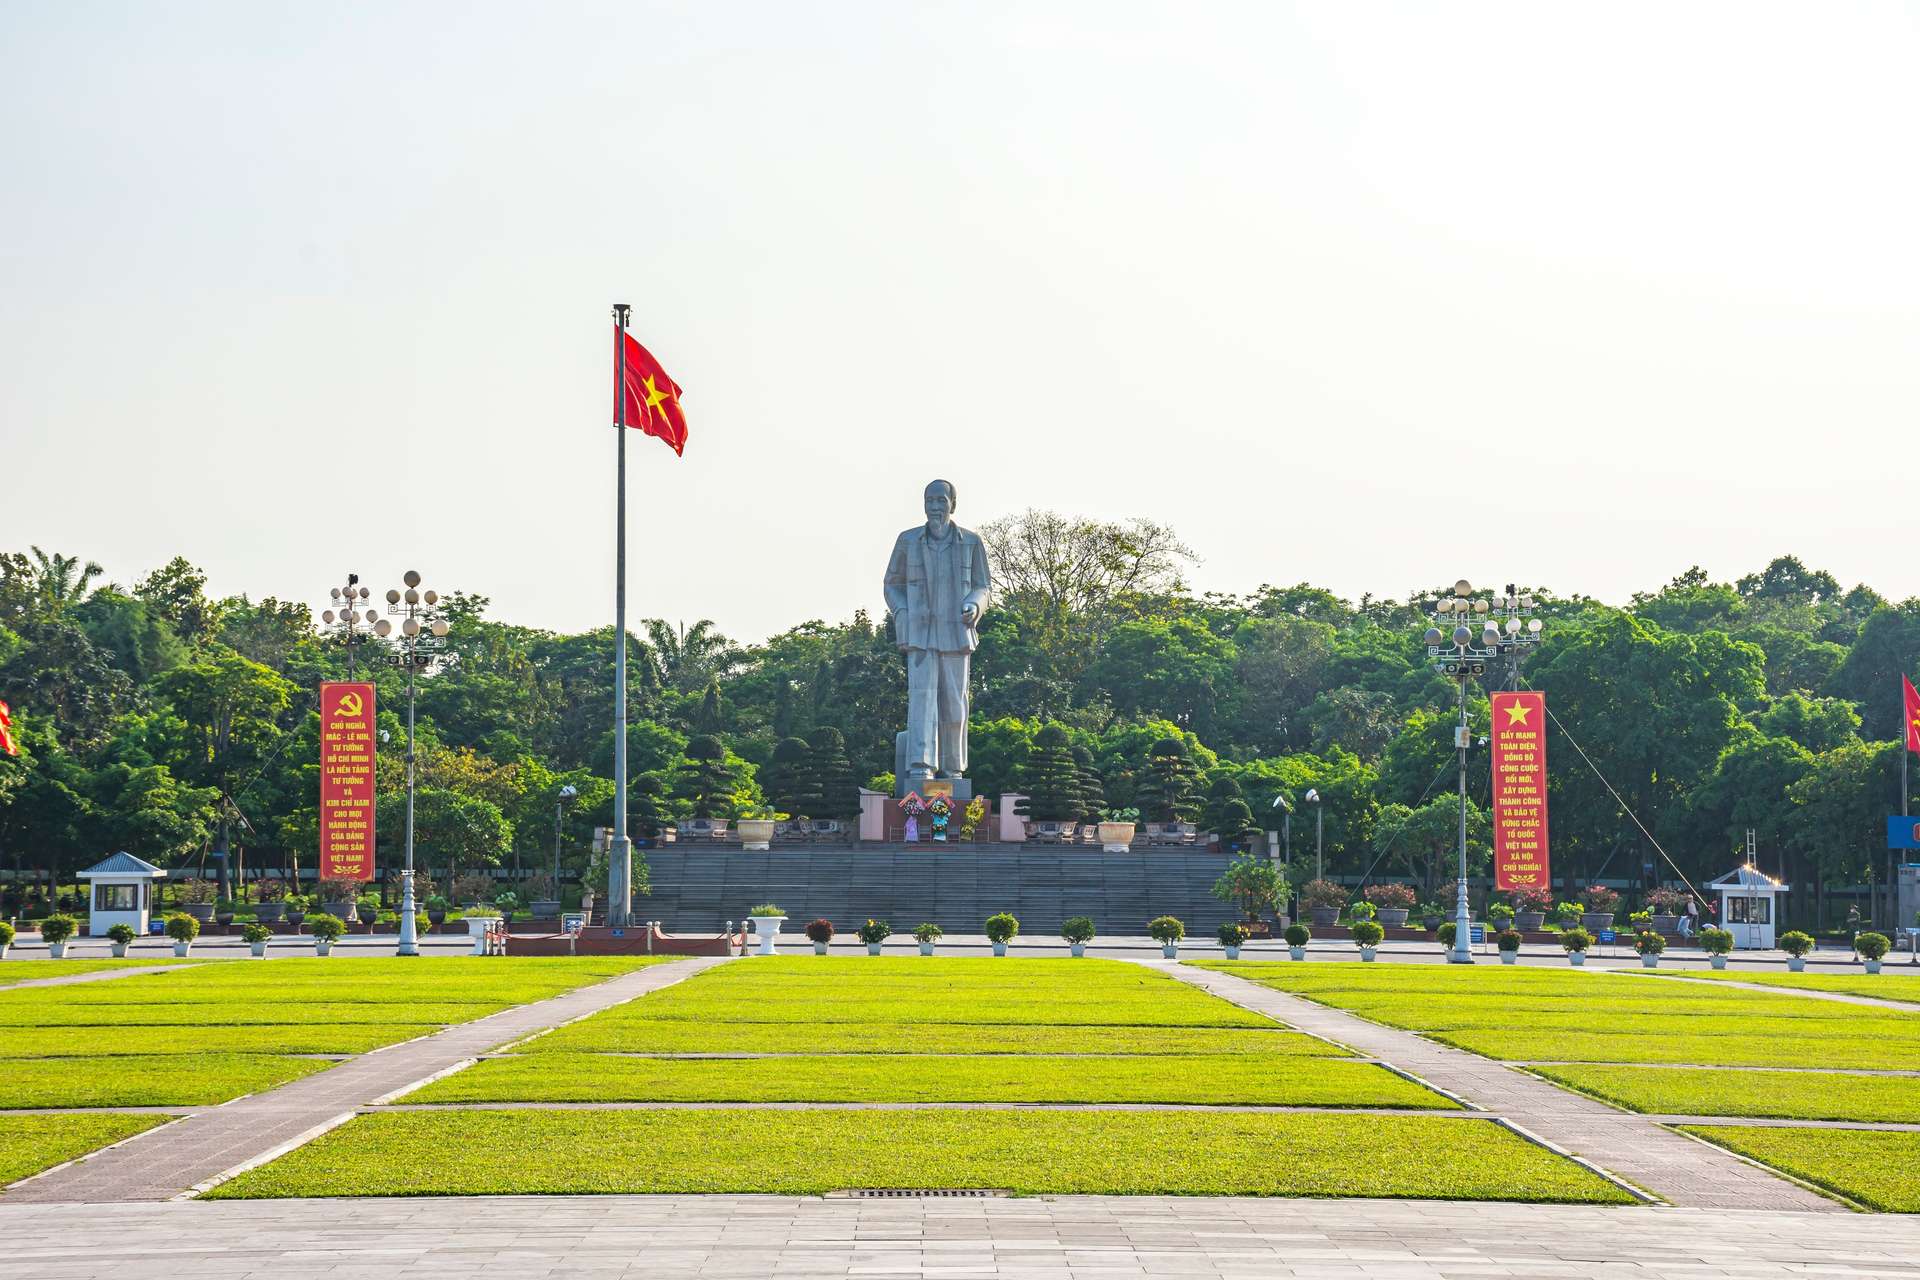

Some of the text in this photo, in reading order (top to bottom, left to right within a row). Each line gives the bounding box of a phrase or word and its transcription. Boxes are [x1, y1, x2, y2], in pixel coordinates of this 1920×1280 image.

[331, 720, 344, 729] CHỦ
[1516, 732, 1536, 741] MẠNH
[343, 743, 364, 751] TƯỞNG
[328, 754, 336, 762] HỒ
[1525, 753, 1534, 762] BỘ
[352, 765, 369, 773] TẢNG
[1520, 764, 1539, 773] CUỘC
[343, 776, 364, 784] TƯỞNG
[1506, 774, 1516, 783] ĐỔI
[344, 786, 352, 795] VÀ
[1504, 786, 1536, 795] XÂY DỰNG
[1499, 797, 1521, 805] THÀNH
[1504, 807, 1537, 817] VÀ BẢO VỆ
[349, 820, 367, 830] ĐỘNG
[331, 831, 344, 839] CỦA
[1508, 829, 1535, 838] TỔ QUỐC
[351, 842, 364, 850] SẢN
[1506, 841, 1520, 850] VIỆT
[331, 854, 344, 863] VIỆT
[1522, 852, 1533, 861] HỘI
[1503, 862, 1541, 871] CHỦ NGHĨA!
